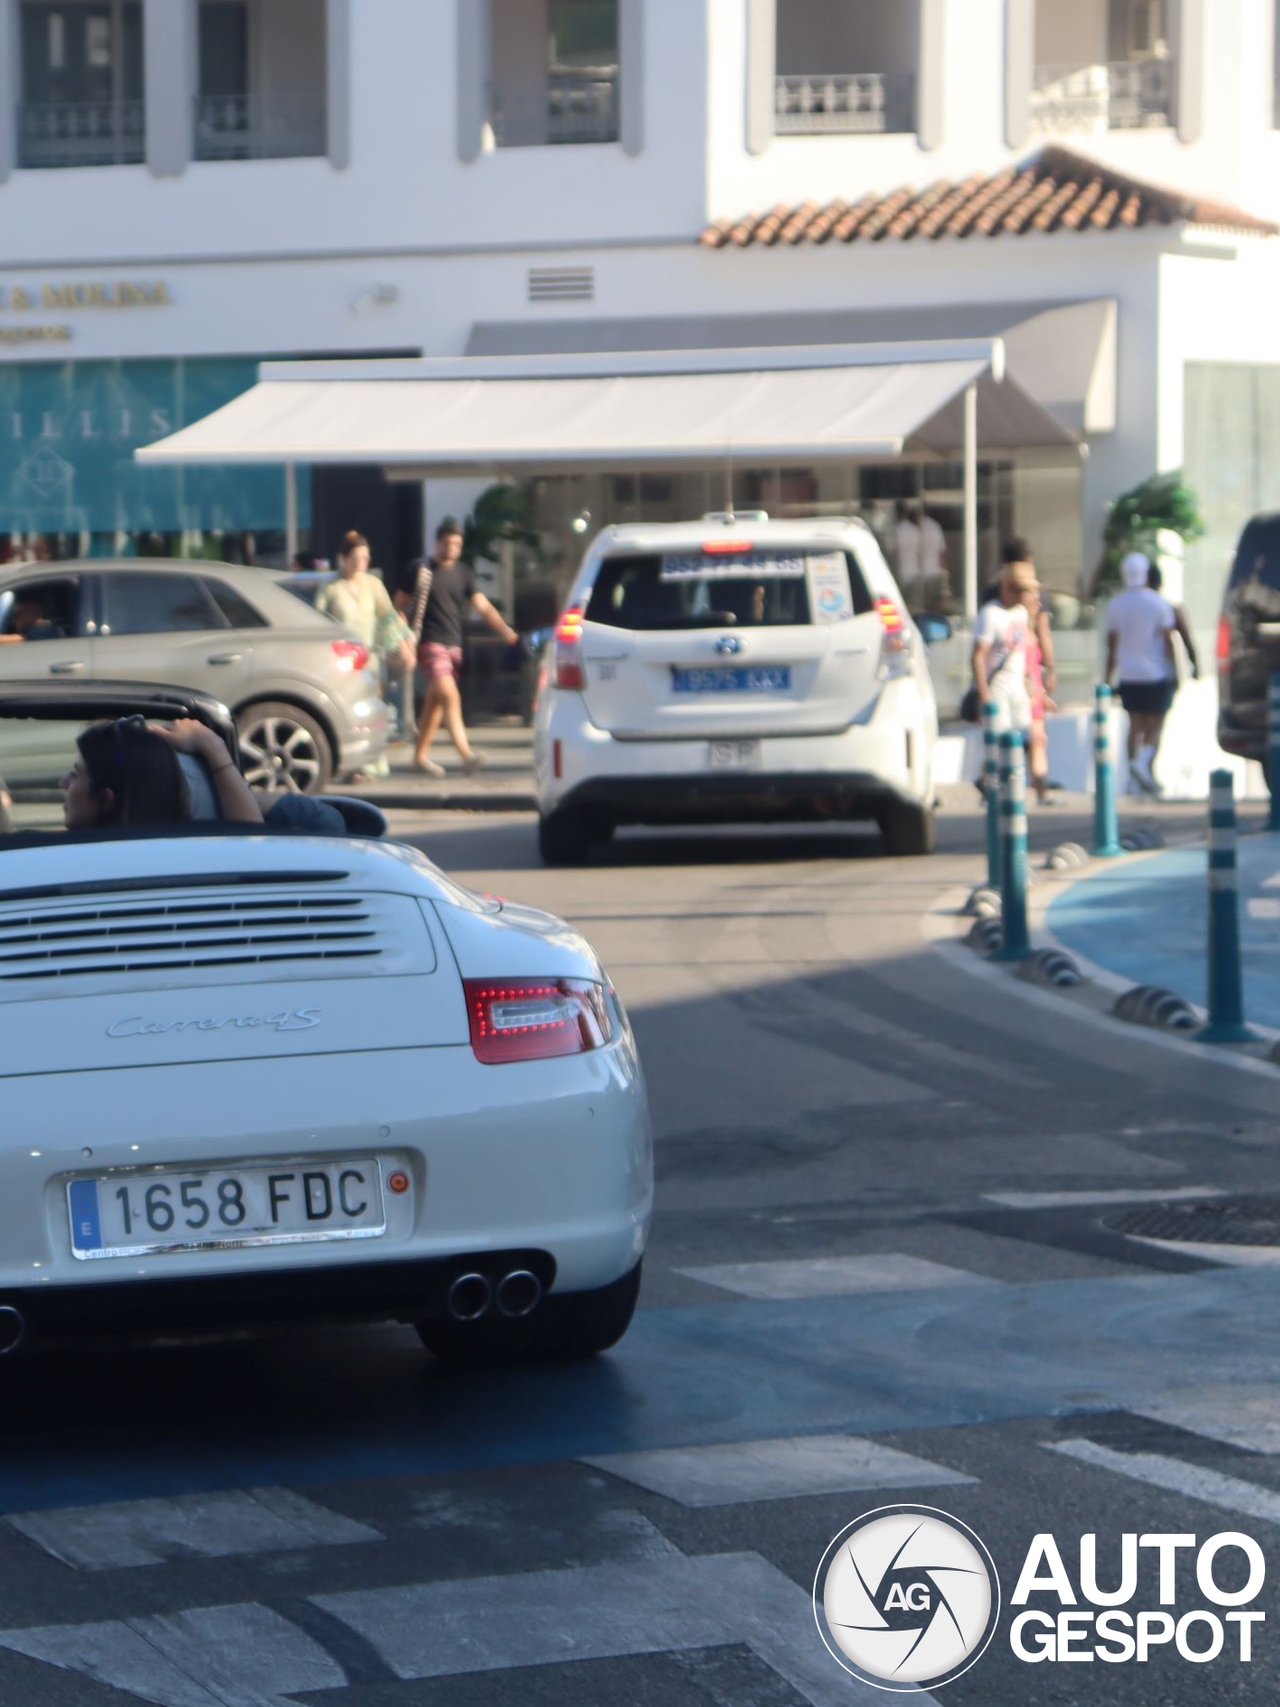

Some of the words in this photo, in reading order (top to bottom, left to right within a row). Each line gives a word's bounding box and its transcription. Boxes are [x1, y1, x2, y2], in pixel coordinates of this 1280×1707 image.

[41, 280, 172, 308] MOLINA
[106, 1016, 260, 1038] Carrera
[263, 1008, 324, 1032] 4S
[115, 1178, 246, 1235] 1658
[267, 1169, 368, 1224] FDC
[81, 1222, 92, 1237] E
